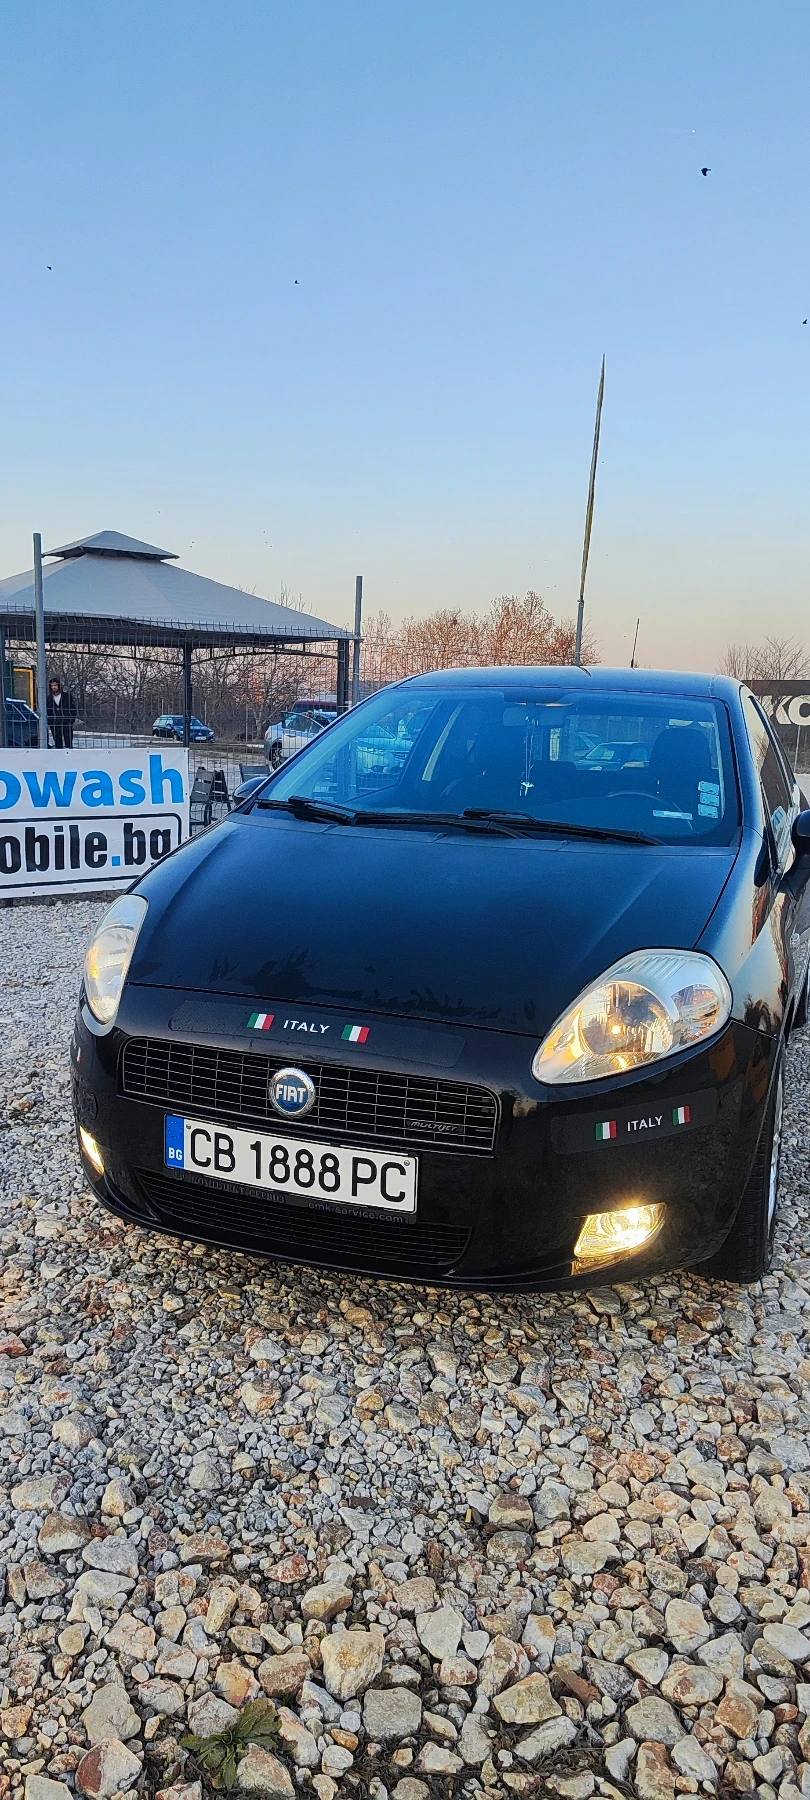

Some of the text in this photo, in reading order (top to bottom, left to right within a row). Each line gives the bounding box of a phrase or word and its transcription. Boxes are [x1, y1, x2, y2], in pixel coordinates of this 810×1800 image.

[283, 1019, 331, 1034] ITALY
[275, 1083, 307, 1104] FIAT
[627, 1115, 663, 1132] ITALY
[168, 1146, 184, 1161] BG
[250, 1140, 341, 1193] 1888
